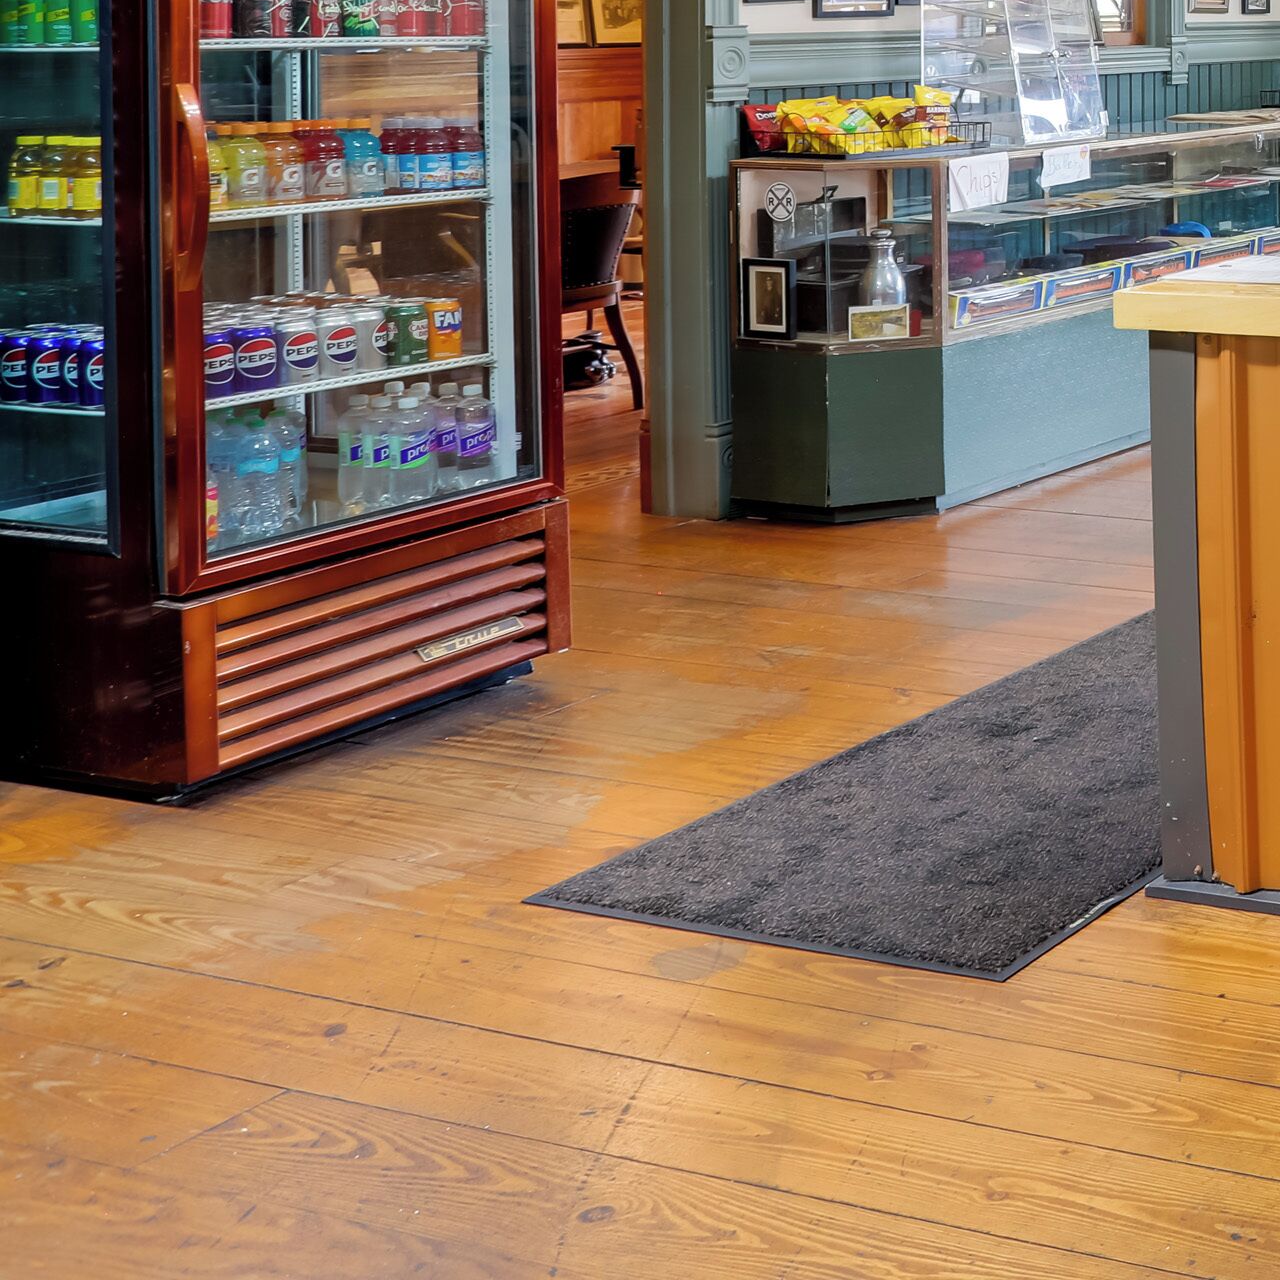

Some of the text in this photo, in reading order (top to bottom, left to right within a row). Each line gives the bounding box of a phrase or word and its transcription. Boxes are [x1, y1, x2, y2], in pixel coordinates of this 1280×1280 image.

[768, 197, 793, 207] R R
[455, 626, 500, 647] true
